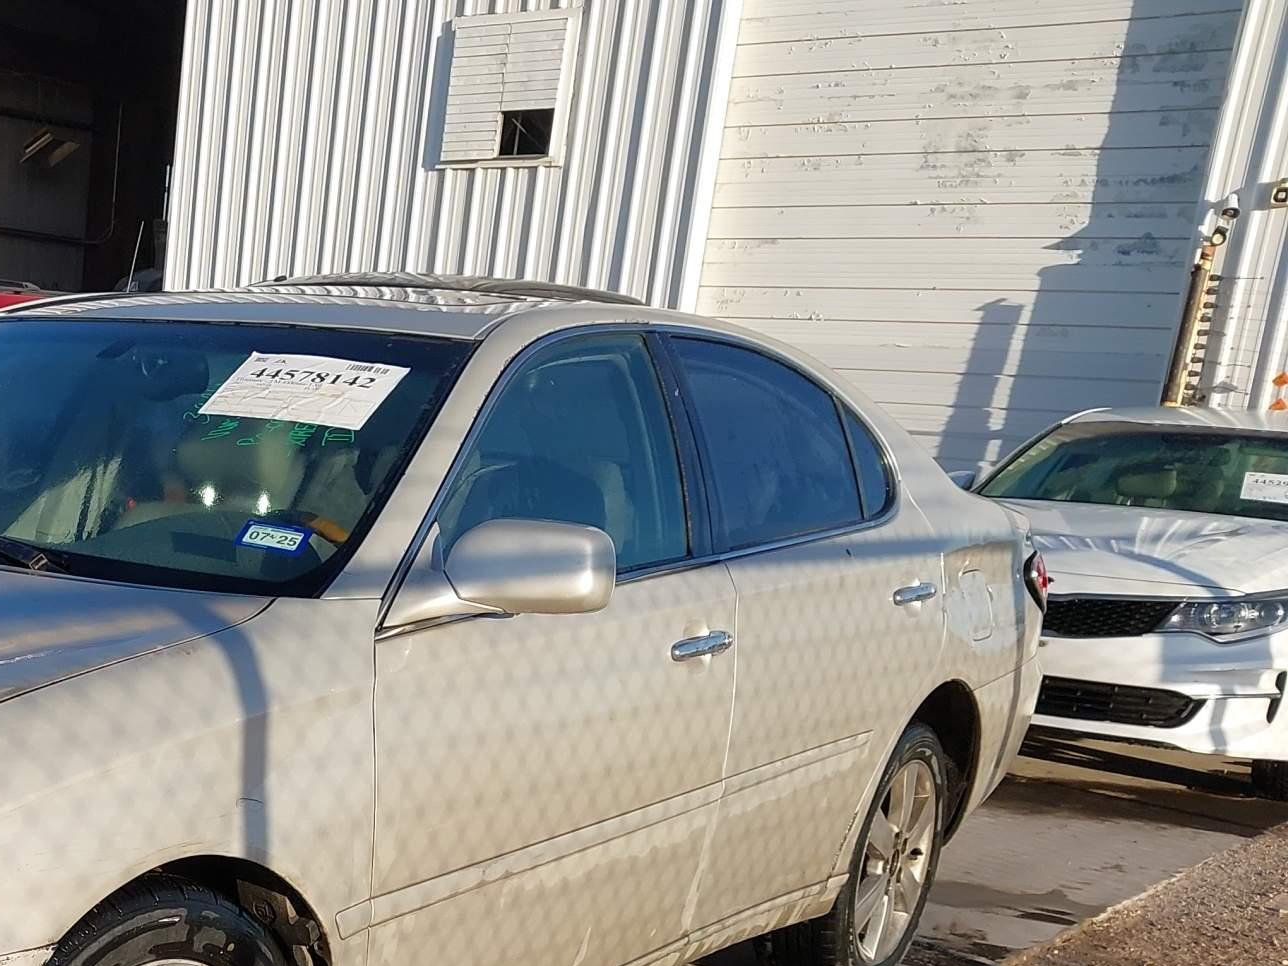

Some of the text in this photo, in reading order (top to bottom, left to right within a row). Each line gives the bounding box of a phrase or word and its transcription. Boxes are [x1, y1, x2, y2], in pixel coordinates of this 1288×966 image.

[250, 367, 377, 389] 44578142
[249, 531, 298, 547] 07 25
